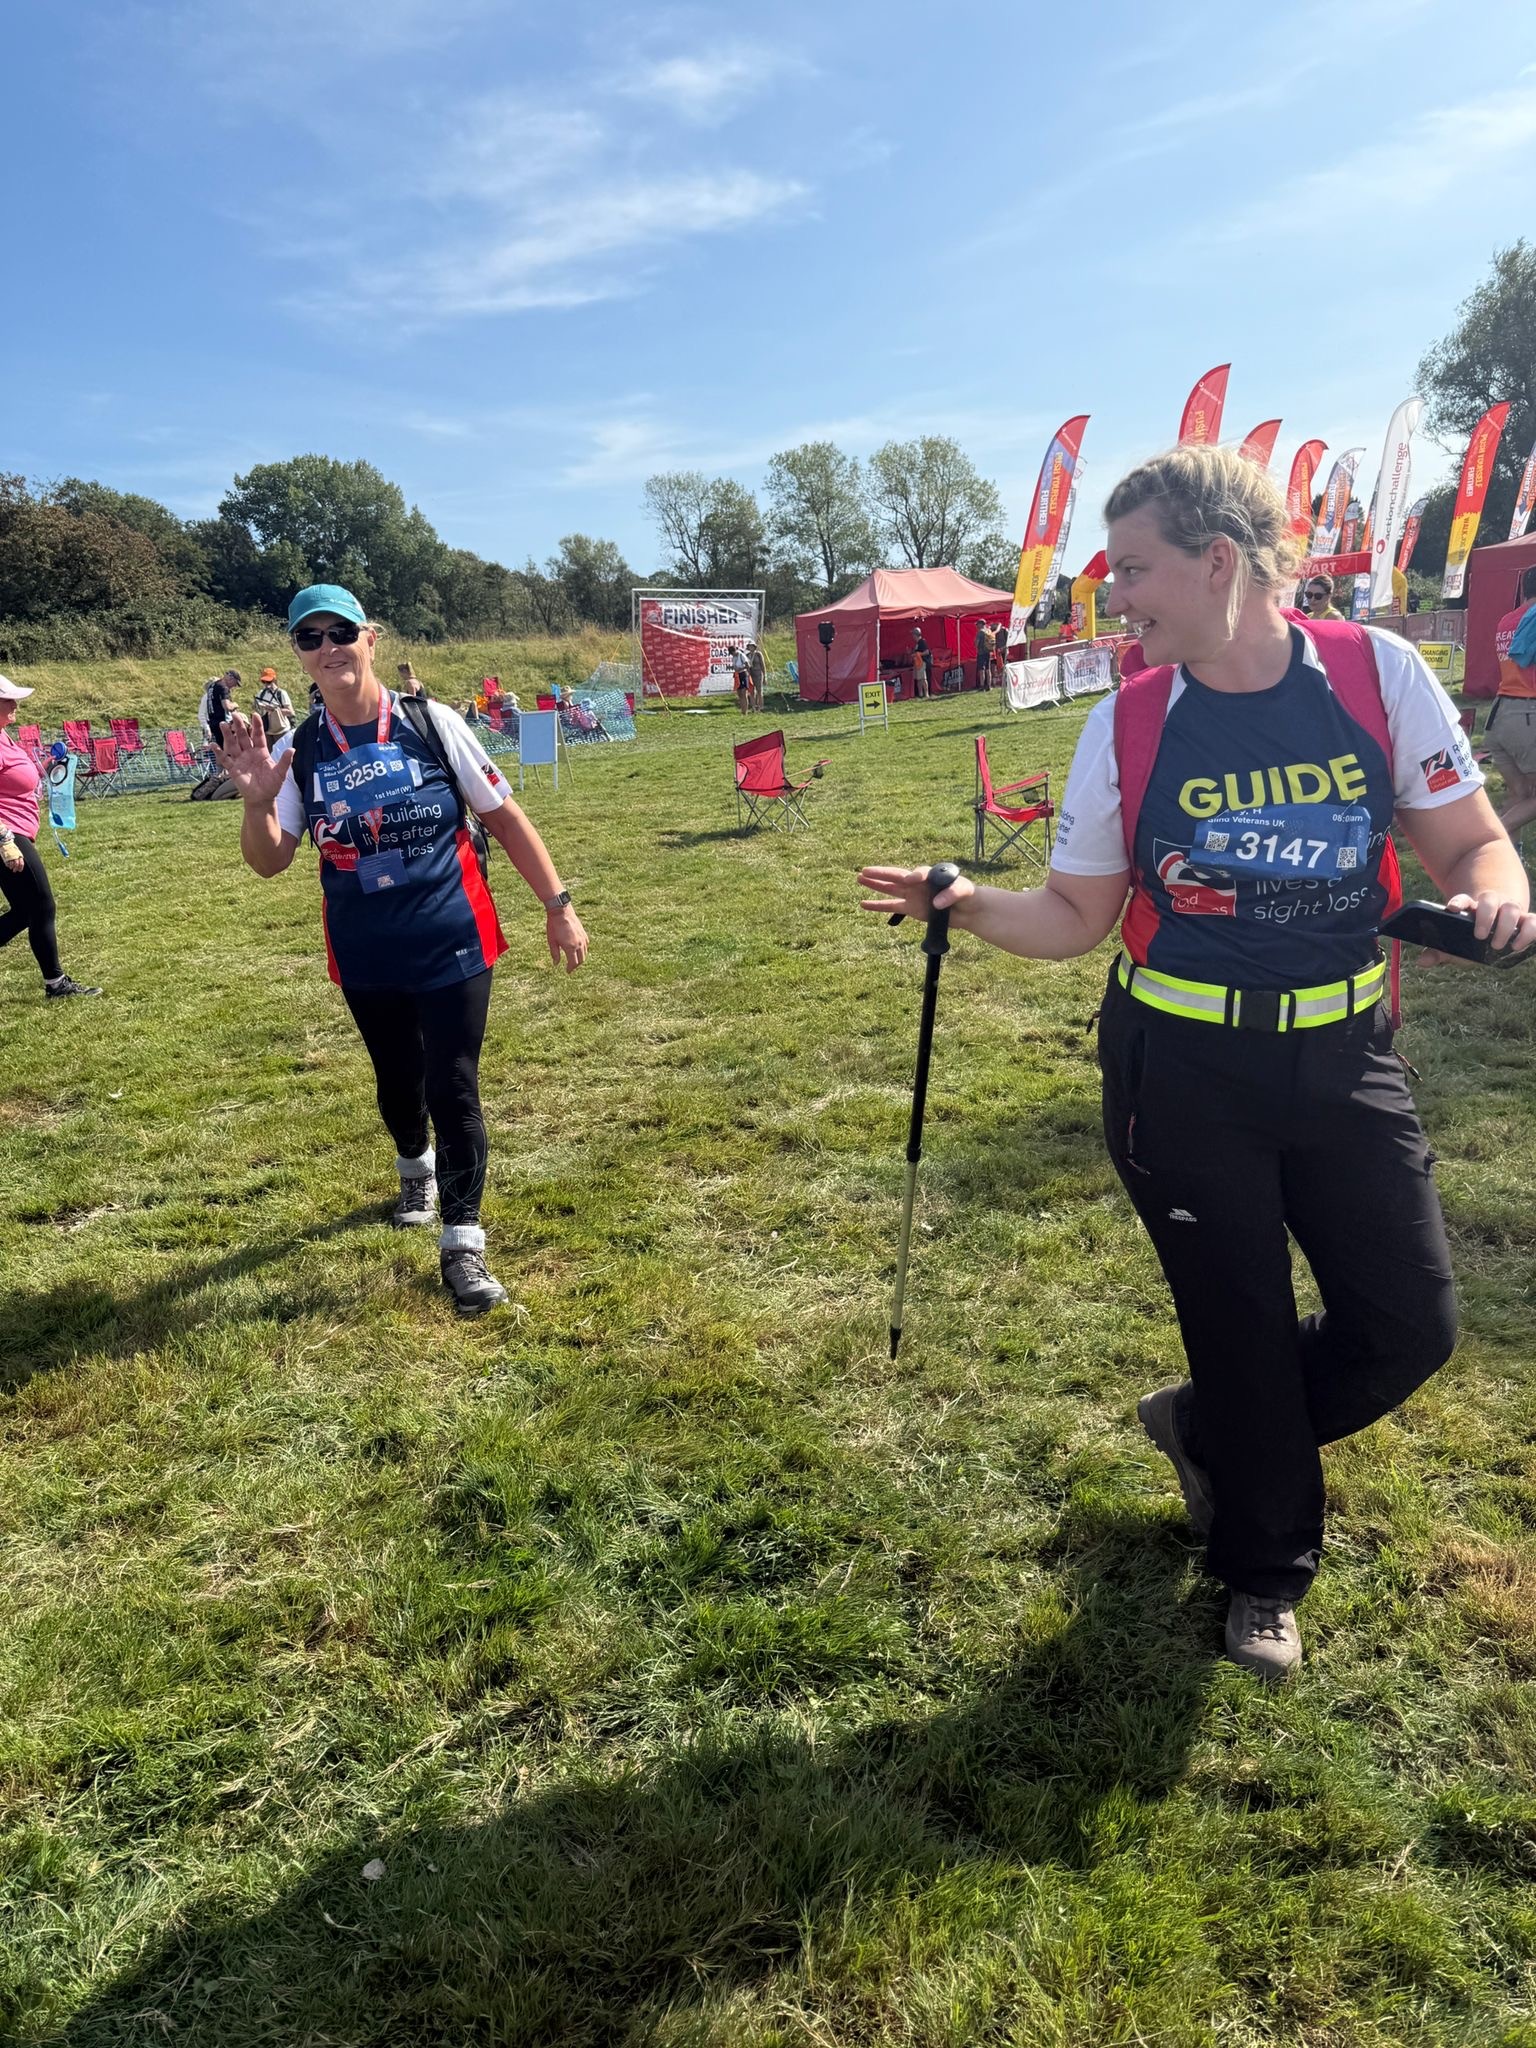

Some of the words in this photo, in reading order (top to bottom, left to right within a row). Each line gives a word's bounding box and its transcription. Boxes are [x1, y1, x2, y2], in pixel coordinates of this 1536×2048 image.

[1385, 442, 1408, 540] actionchallenge
[1039, 489, 1050, 526] FURTHER
[663, 608, 738, 624] FINISHER
[710, 635, 744, 648] SOUTH
[710, 649, 732, 657] COAS
[344, 761, 387, 790] 3258
[1179, 753, 1368, 818] GUIDE
[358, 803, 442, 828] Rbuilding
[1232, 816, 1270, 826] Veterans
[1272, 820, 1286, 828] UK
[402, 824, 438, 840] after
[407, 843, 434, 859] loss
[1236, 831, 1328, 869] 3147
[1253, 899, 1323, 924] sight
